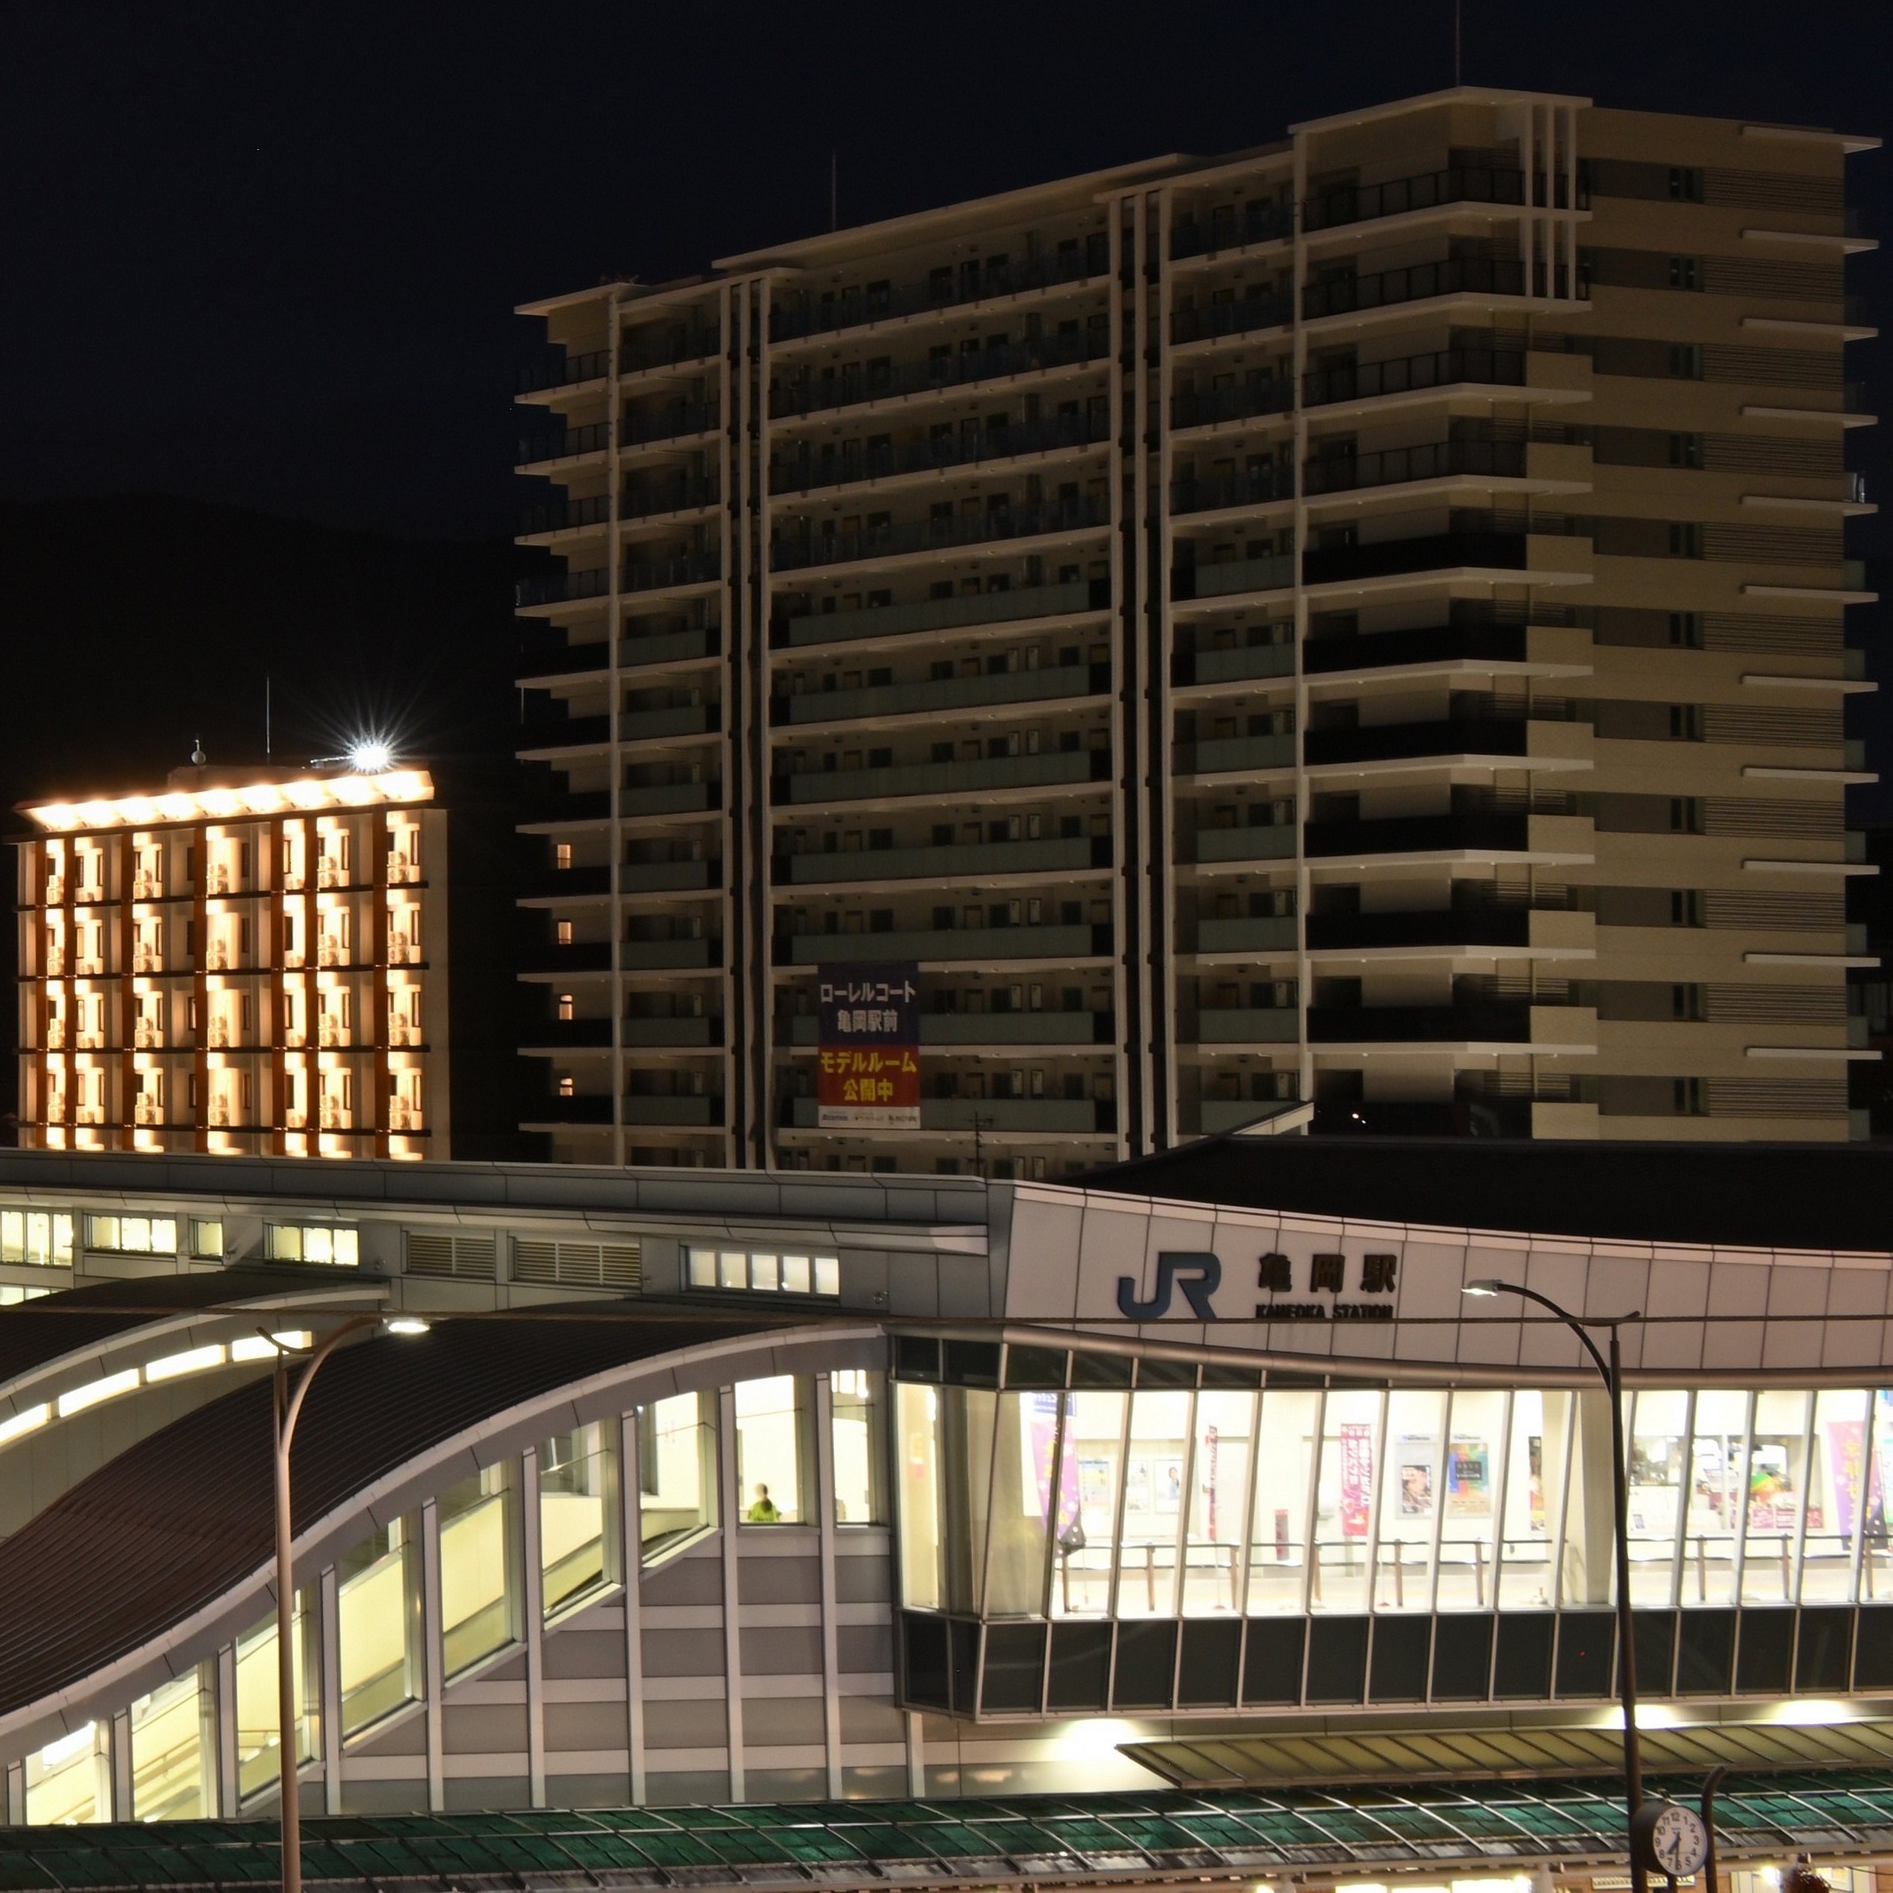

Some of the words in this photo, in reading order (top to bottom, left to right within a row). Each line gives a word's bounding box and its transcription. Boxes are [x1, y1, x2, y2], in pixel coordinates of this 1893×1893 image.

[820, 980, 916, 1003] ローレルコート
[837, 1009, 898, 1033] 亀岡駅前
[820, 1051, 917, 1074] モデルルーム
[843, 1078, 893, 1102] 公開中
[1257, 1253, 1398, 1293] 亀岡駅
[1117, 1252, 1221, 1319] JR
[1255, 1303, 1327, 1319] KAMEOKA
[1331, 1303, 1394, 1319] STATION
